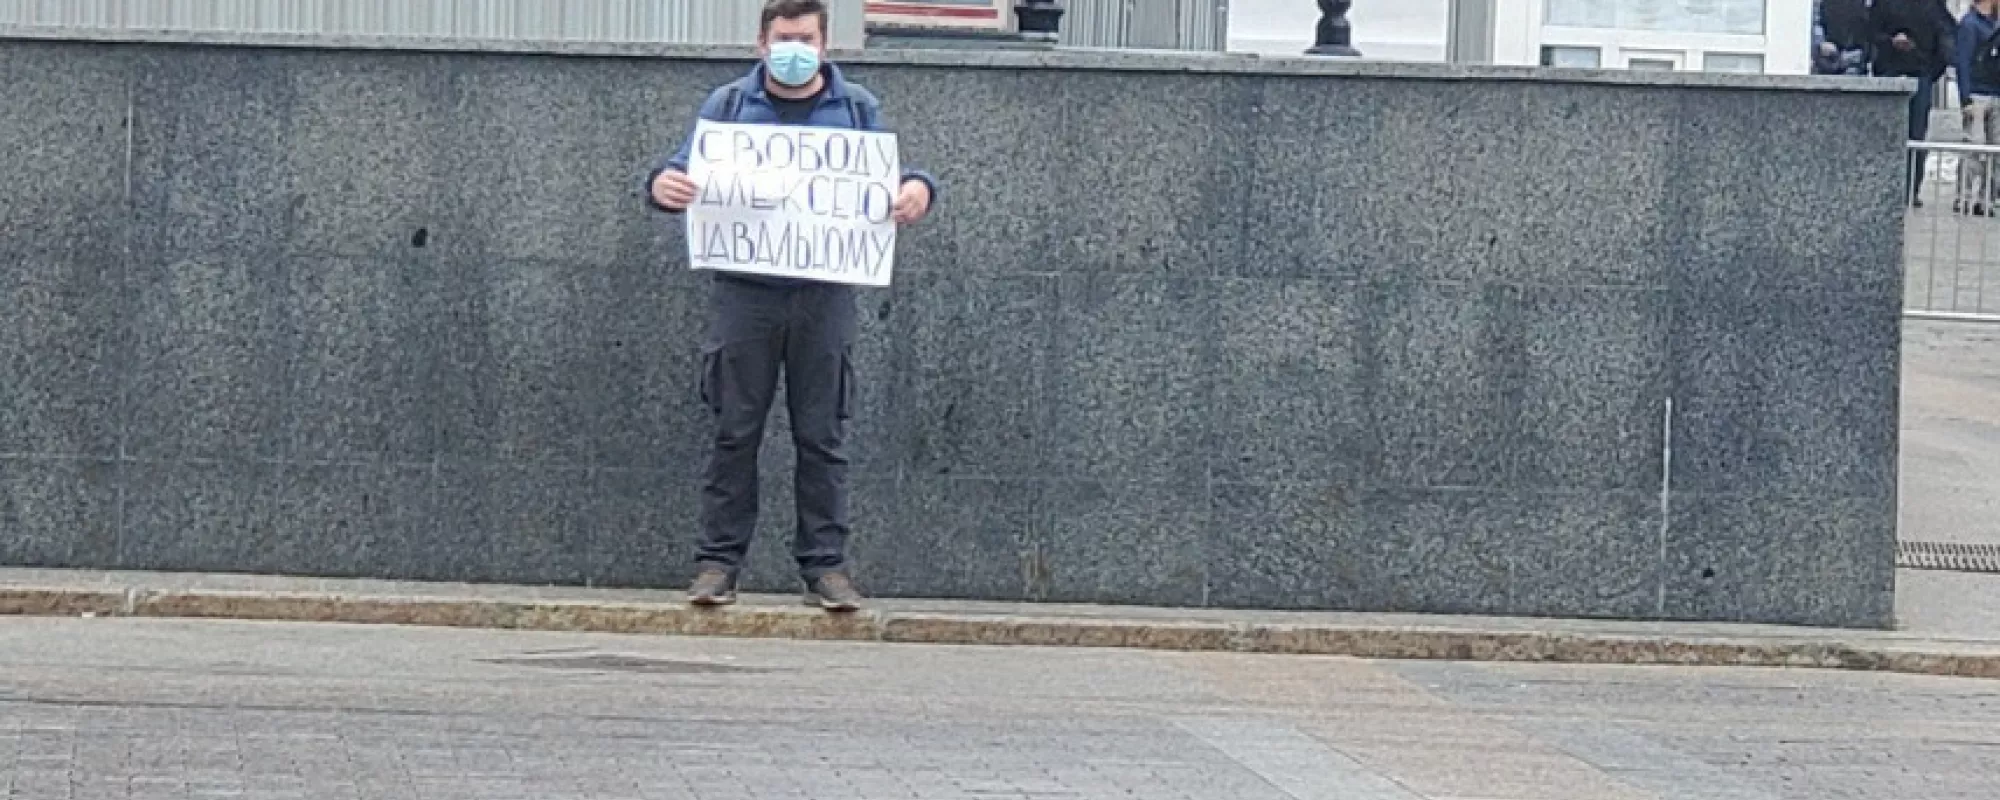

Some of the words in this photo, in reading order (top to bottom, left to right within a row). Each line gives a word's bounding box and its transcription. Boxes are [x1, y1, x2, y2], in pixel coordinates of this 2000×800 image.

[699, 129, 896, 178] СВОБОДУ
[700, 170, 892, 224] АЛЕКСЕЮ
[691, 218, 894, 277] НАВАЛЬНОМУ
